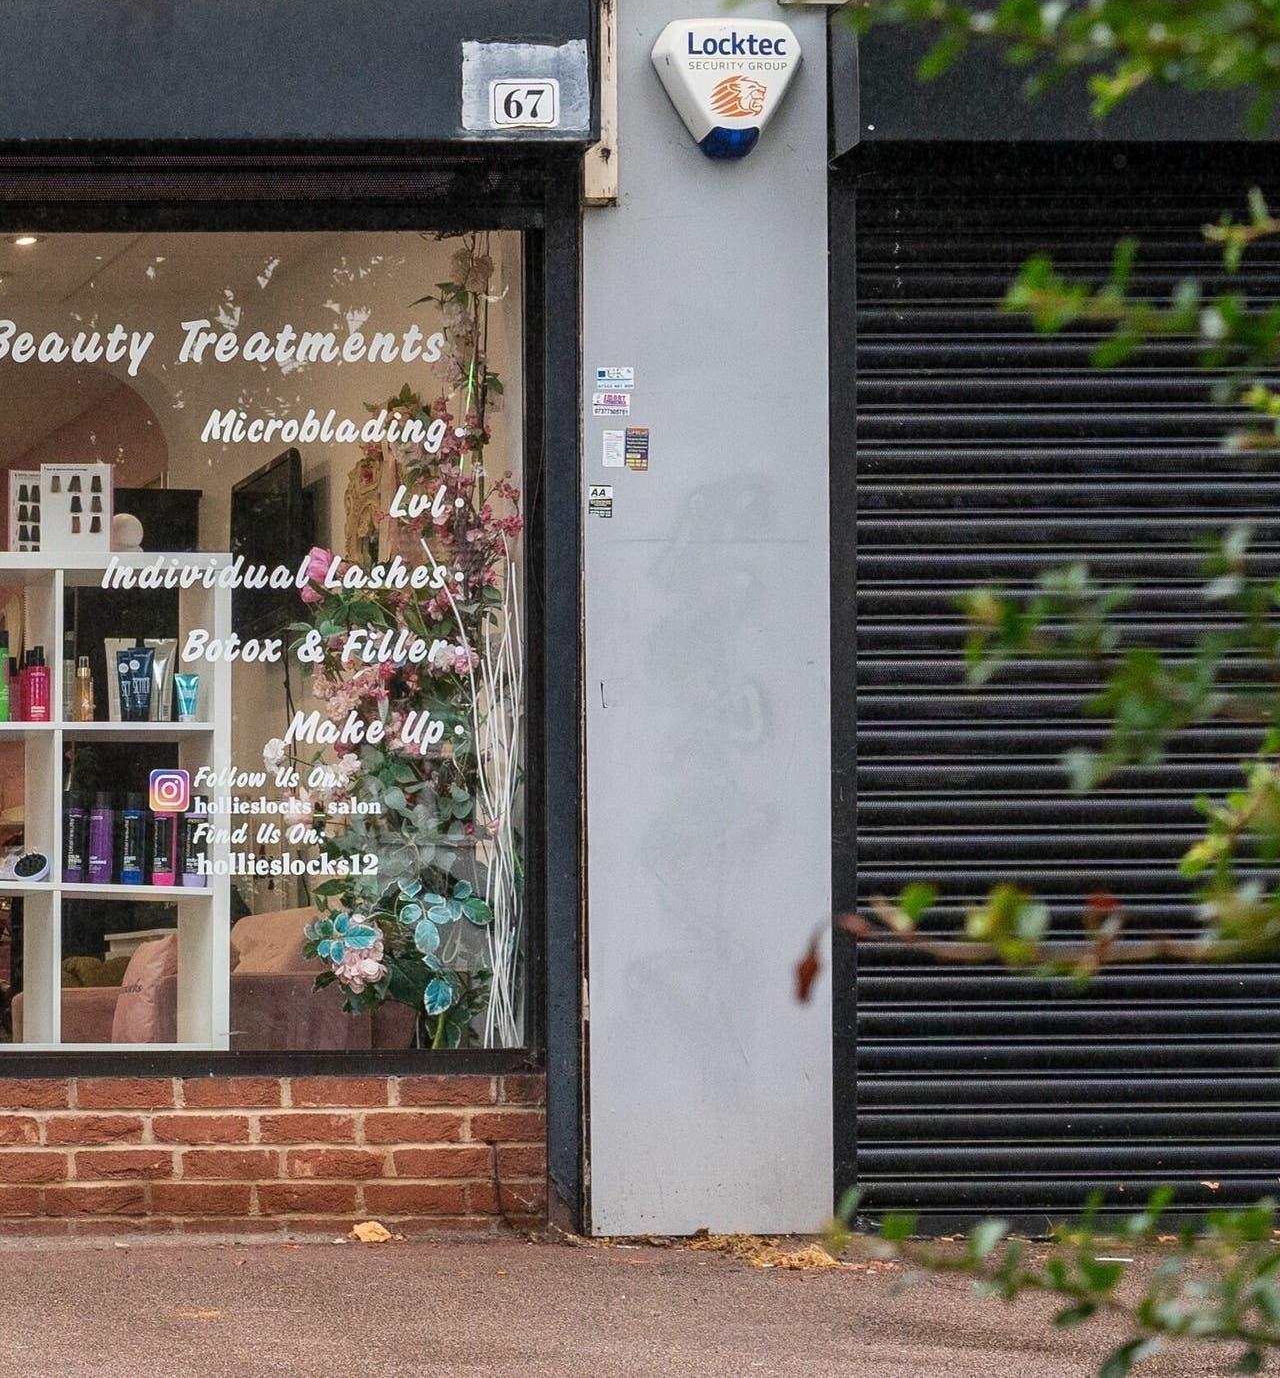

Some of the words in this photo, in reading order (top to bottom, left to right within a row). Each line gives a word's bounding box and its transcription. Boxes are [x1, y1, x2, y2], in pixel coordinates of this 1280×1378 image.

[687, 31, 787, 56] Locktec
[688, 61, 744, 71] SECURITY
[747, 61, 788, 71] GROUP
[503, 88, 545, 120] 67
[176, 318, 445, 364] Treatments
[200, 408, 447, 453] Microblading
[388, 484, 447, 518] Lvl
[101, 555, 310, 590] Individual
[324, 556, 448, 590] Lashes
[181, 628, 282, 663] Botox
[295, 629, 325, 663] &
[340, 628, 448, 663] Filler
[285, 710, 386, 745] Make
[400, 710, 445, 756] Up
[193, 766, 267, 788] Follow
[274, 766, 300, 788] Us
[192, 822, 249, 845] Find
[256, 822, 281, 845] Us
[290, 822, 326, 845] On:
[196, 852, 380, 877] hollieslocks12
